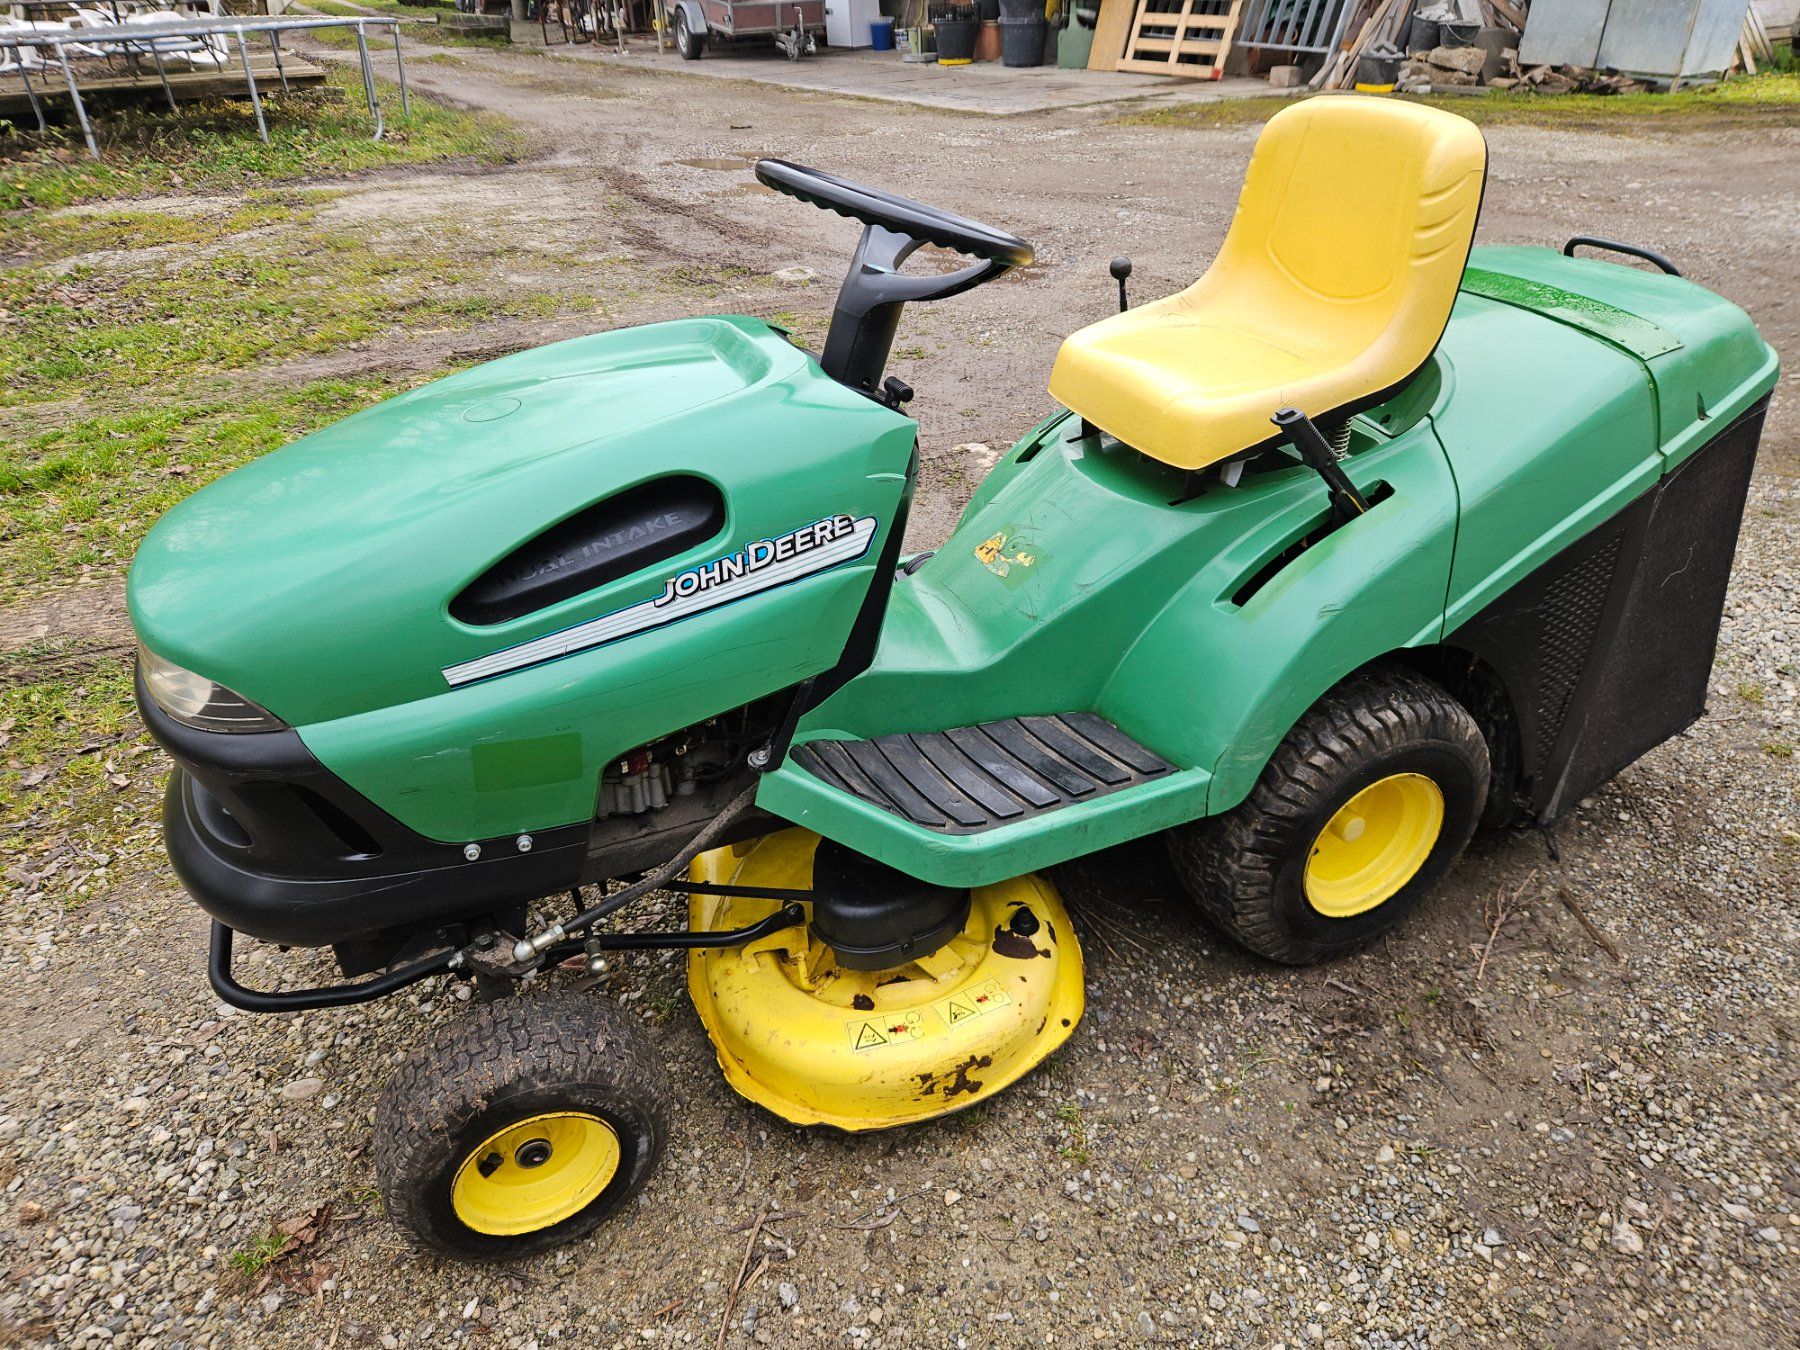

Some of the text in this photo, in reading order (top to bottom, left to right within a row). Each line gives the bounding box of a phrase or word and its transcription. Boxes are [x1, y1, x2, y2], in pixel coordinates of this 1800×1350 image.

[581, 511, 683, 559] INTAKE
[654, 514, 855, 607] JOHN DEERE
